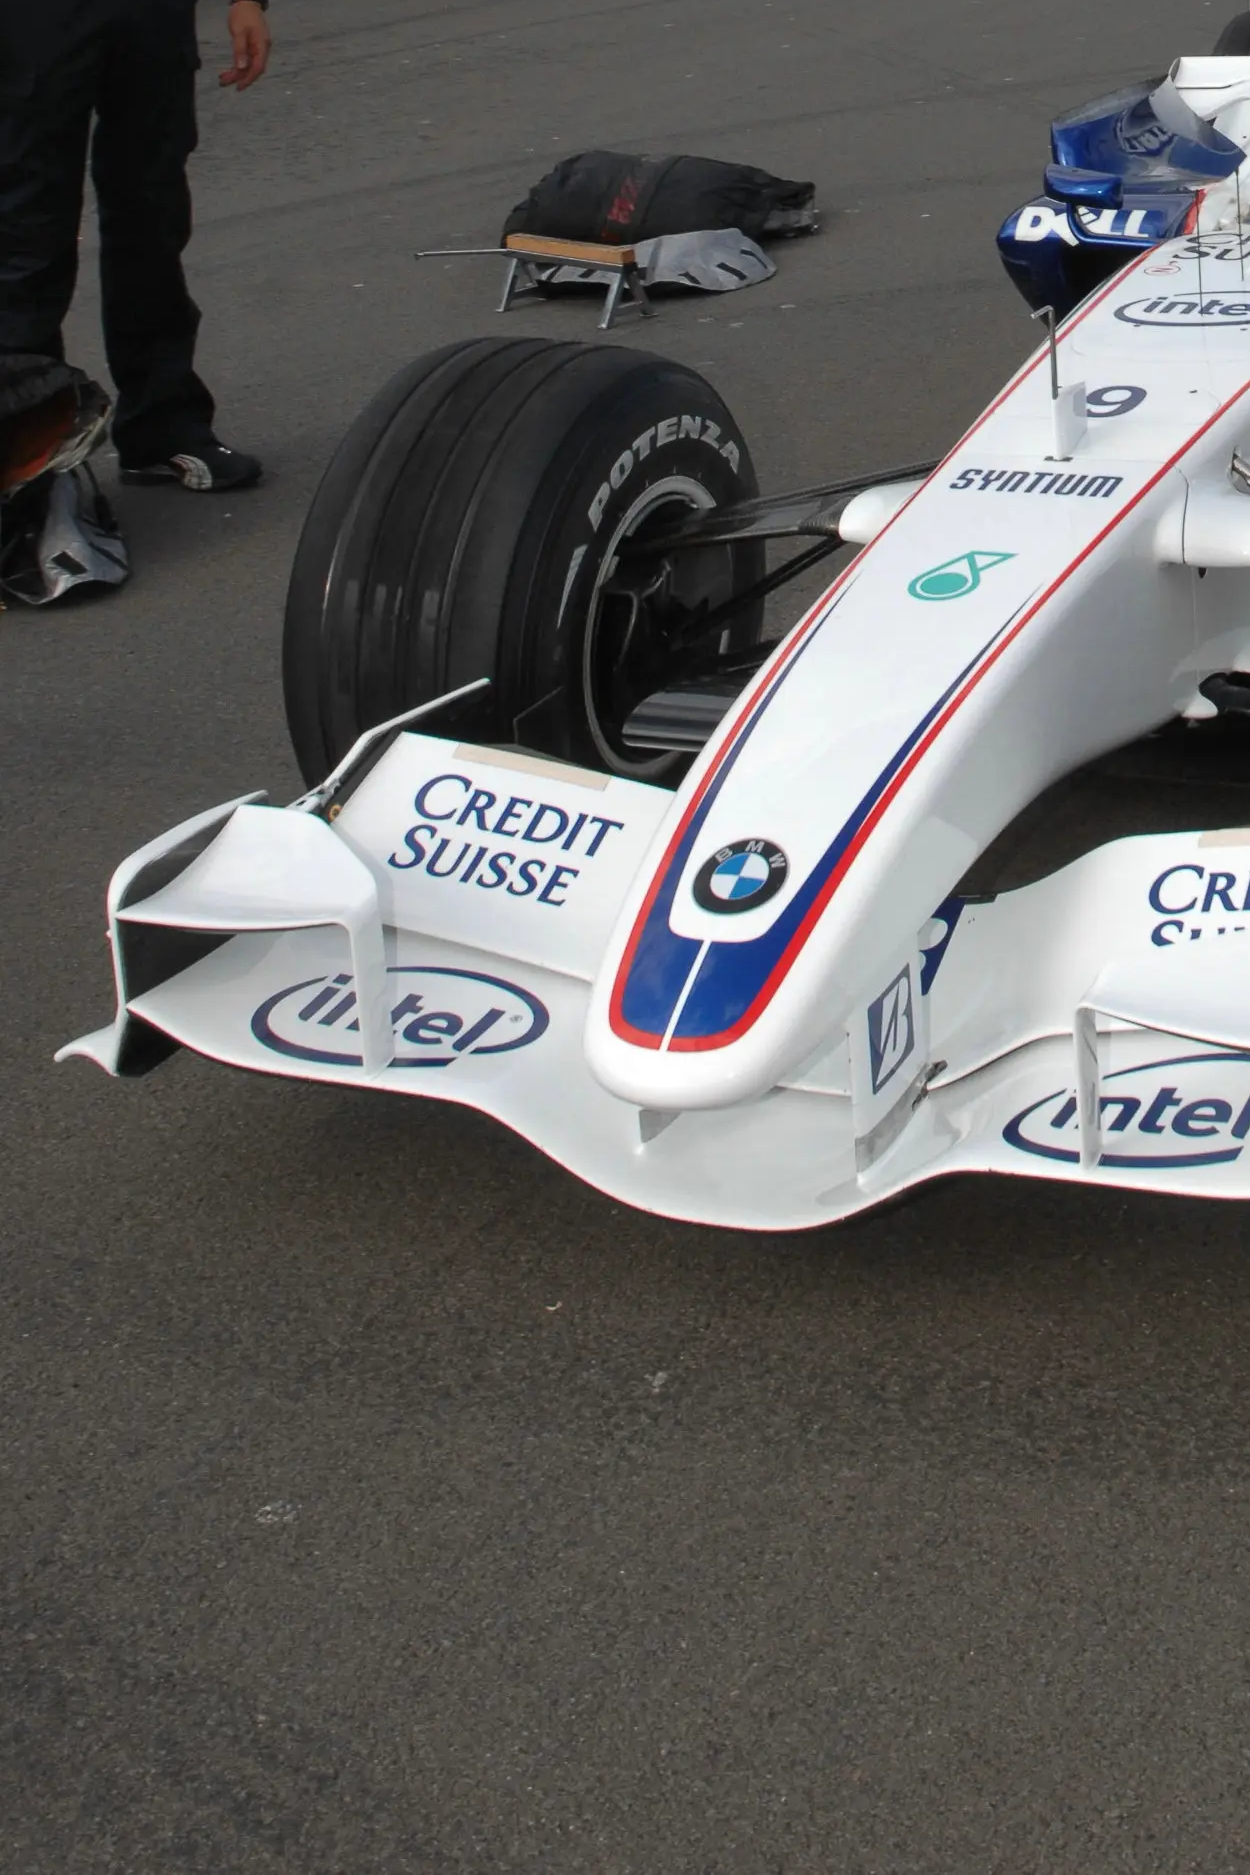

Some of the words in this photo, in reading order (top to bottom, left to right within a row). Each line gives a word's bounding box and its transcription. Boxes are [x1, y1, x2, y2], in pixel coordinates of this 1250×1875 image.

[1014, 205, 1150, 247] DELL
[1074, 385, 1147, 418] 9
[587, 414, 741, 533] POTENZA
[949, 468, 1124, 498] SYNTIUM
[413, 773, 625, 858] CREDIT
[388, 823, 581, 907] SUISSE
[714, 839, 786, 868] BMW
